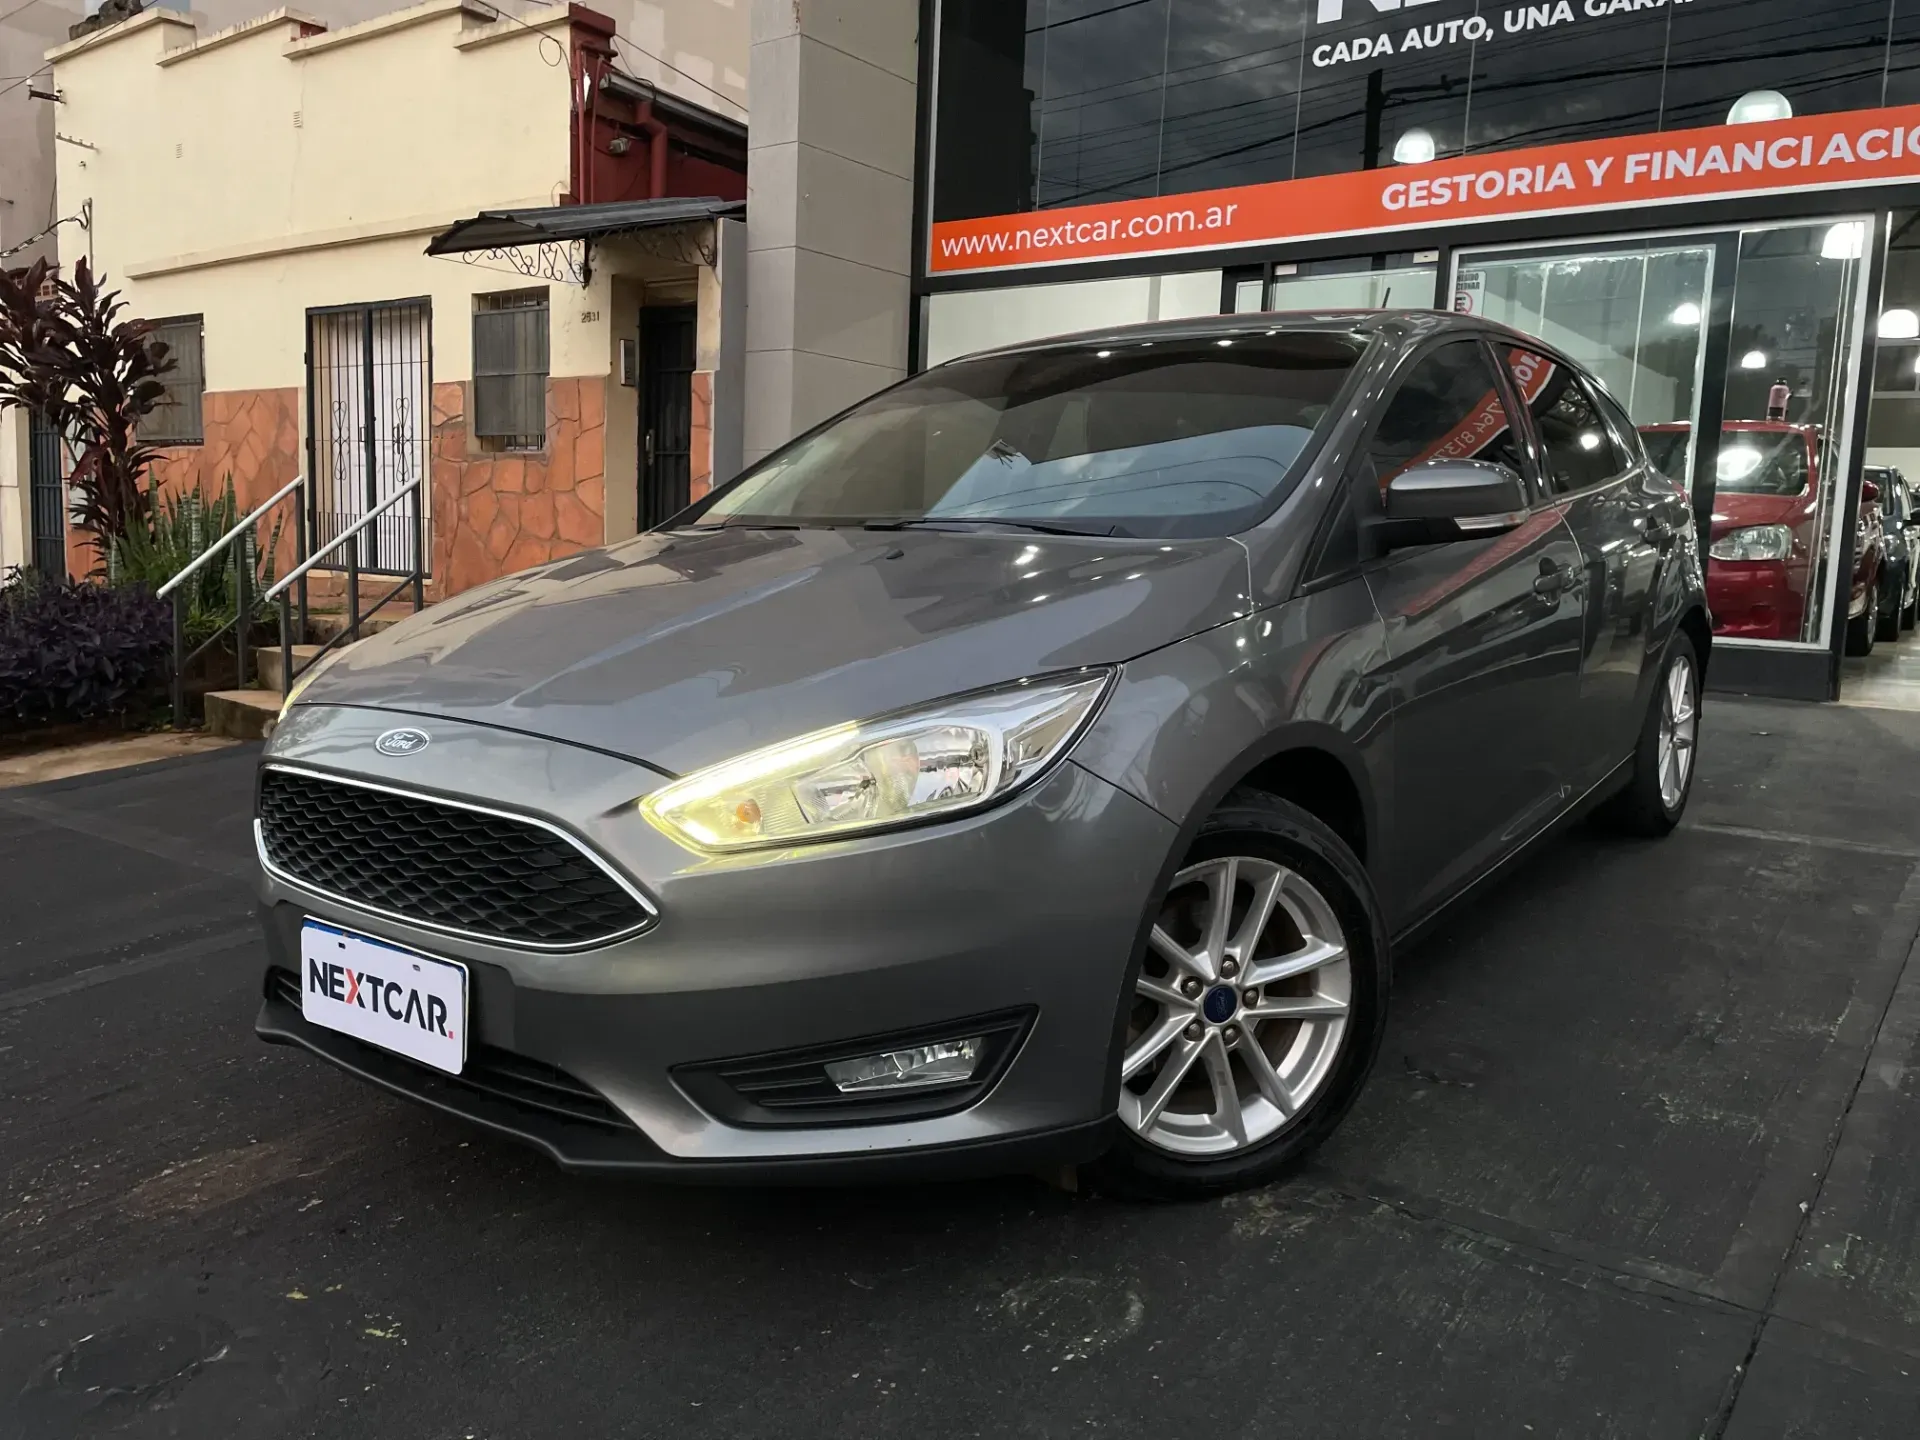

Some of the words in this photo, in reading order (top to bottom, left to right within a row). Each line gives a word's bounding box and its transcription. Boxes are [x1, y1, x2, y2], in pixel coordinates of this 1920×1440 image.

[1312, 33, 1394, 67] CADA
[1400, 16, 1494, 52] AUTO,
[1503, 0, 1575, 33] UNA
[1382, 162, 1576, 211] GESTORIA
[1585, 157, 1614, 187] Y
[941, 203, 1238, 257] www.nextcar.com.ar
[385, 732, 418, 750] Ford
